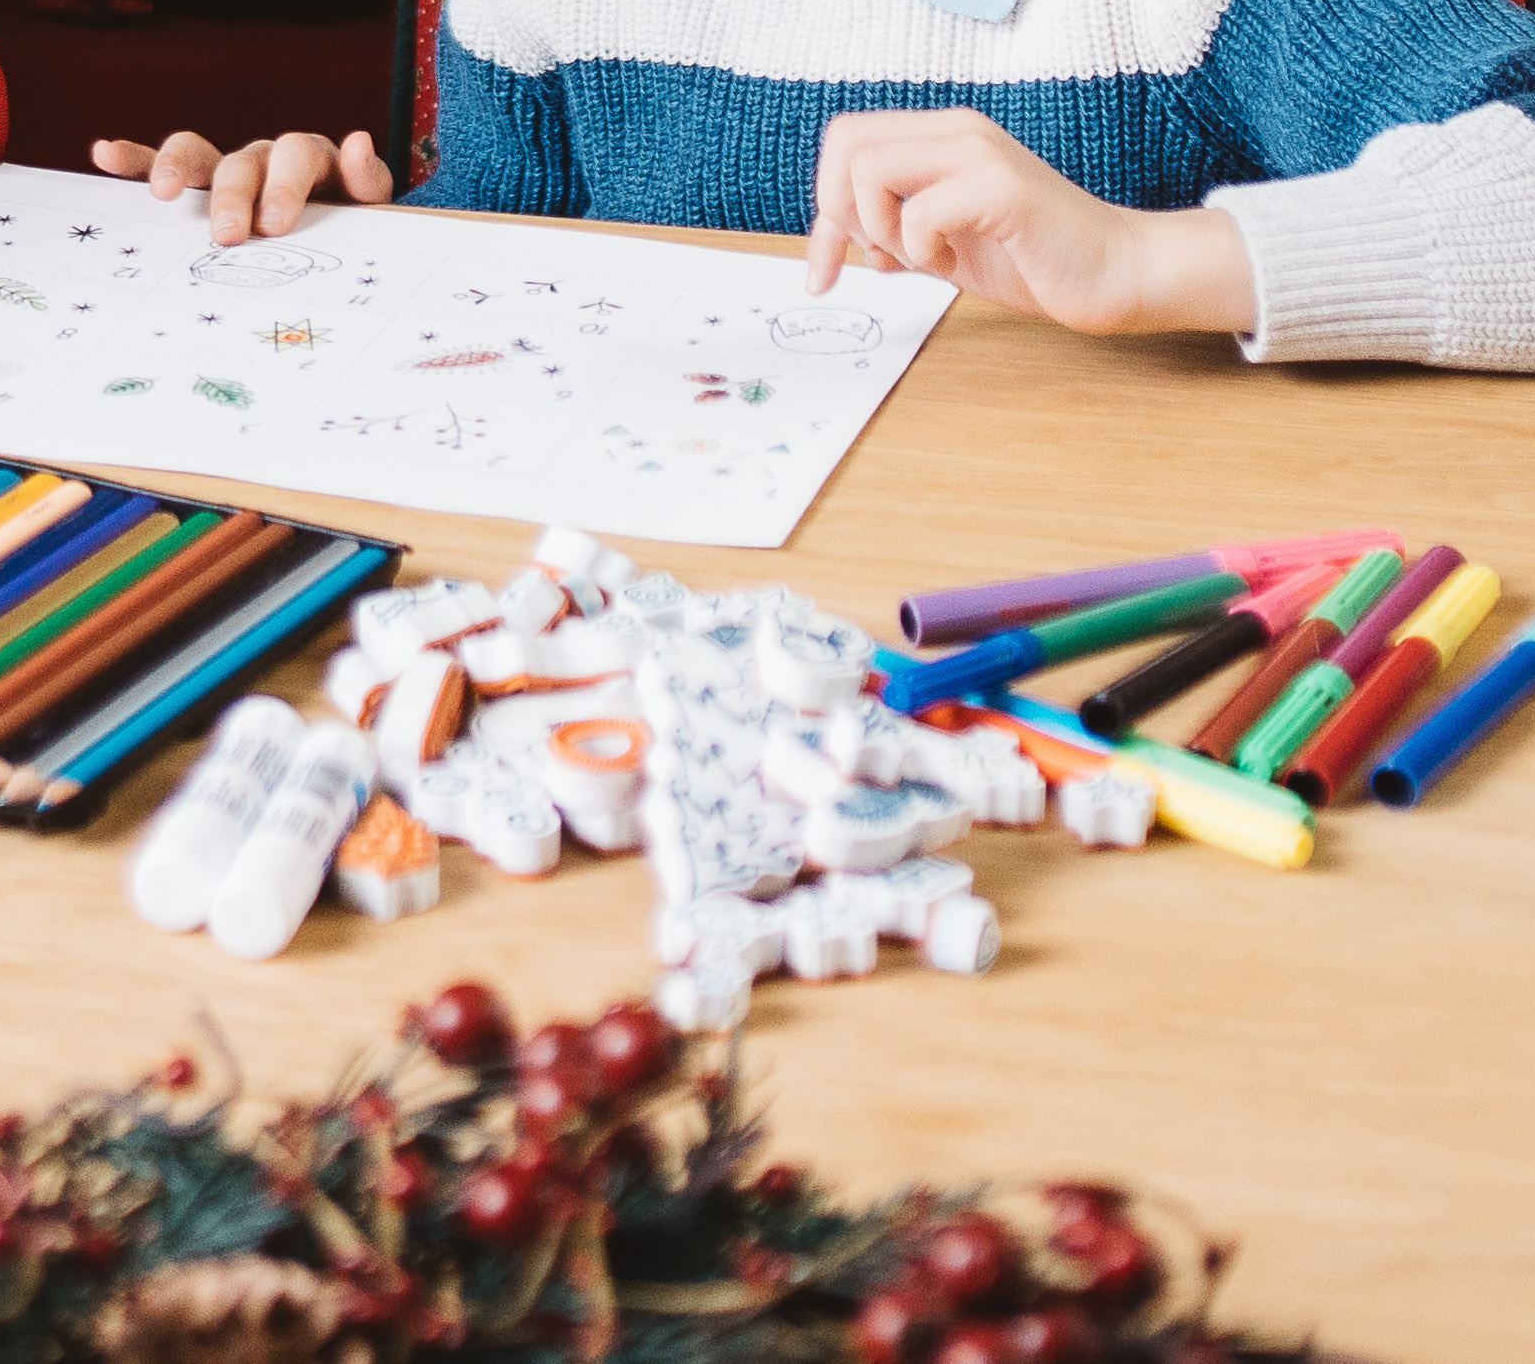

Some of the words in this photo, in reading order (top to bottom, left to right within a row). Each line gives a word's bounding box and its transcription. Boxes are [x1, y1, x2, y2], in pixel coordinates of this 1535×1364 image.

[112, 267, 141, 279] 12
[56, 328, 79, 340] 8
[579, 324, 610, 336] 10
